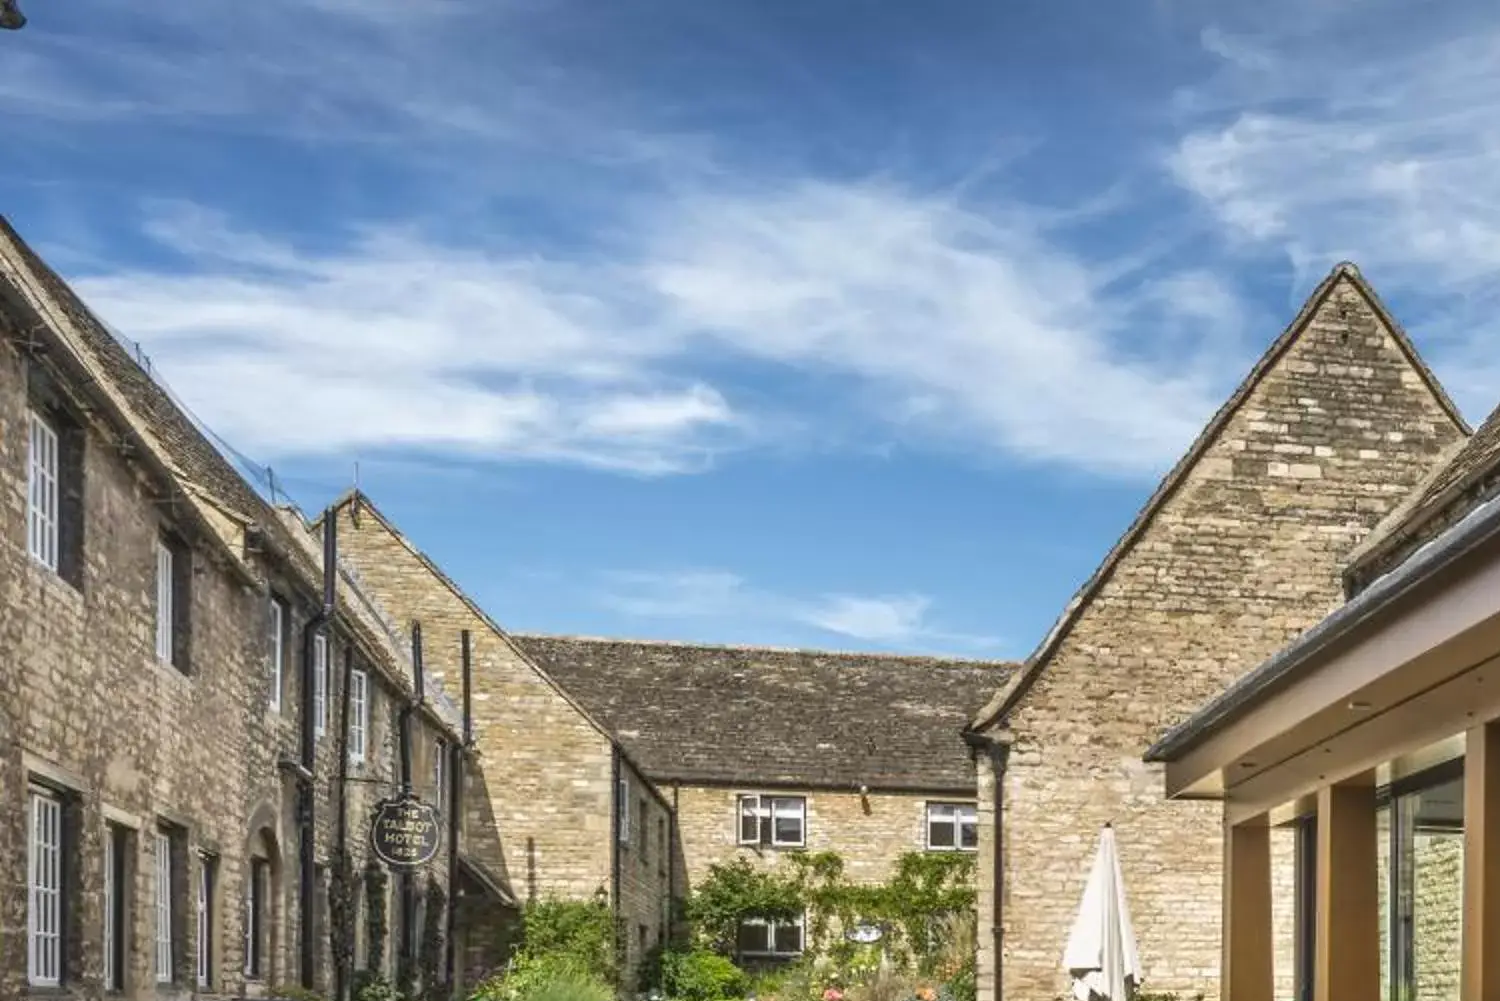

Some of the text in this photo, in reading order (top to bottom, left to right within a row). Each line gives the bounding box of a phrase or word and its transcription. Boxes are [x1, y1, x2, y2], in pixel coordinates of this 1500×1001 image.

[398, 808, 419, 819] THE
[383, 819, 432, 833] TALBOT
[384, 833, 429, 847] HOTEL
